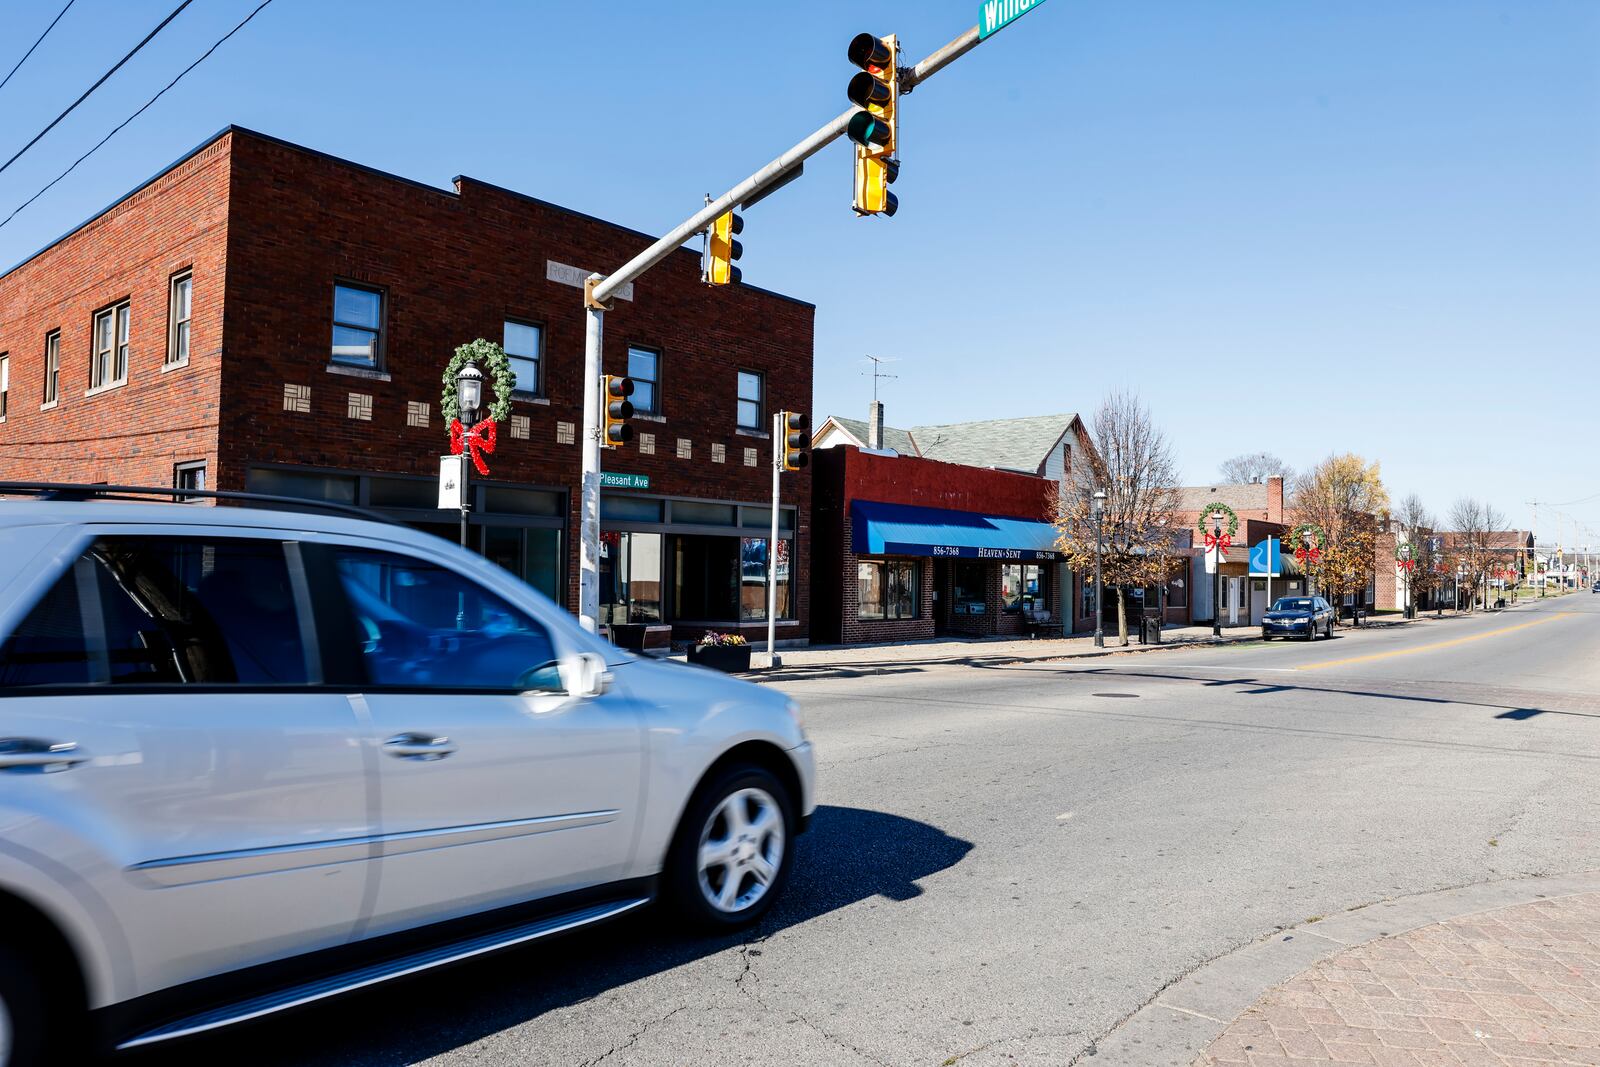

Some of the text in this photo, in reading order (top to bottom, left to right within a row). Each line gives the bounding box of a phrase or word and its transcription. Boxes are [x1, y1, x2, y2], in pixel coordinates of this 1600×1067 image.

[600, 473, 649, 487] Pleasant Ave
[933, 546, 960, 556] 856-7368
[1036, 551, 1055, 560] 856-7368
